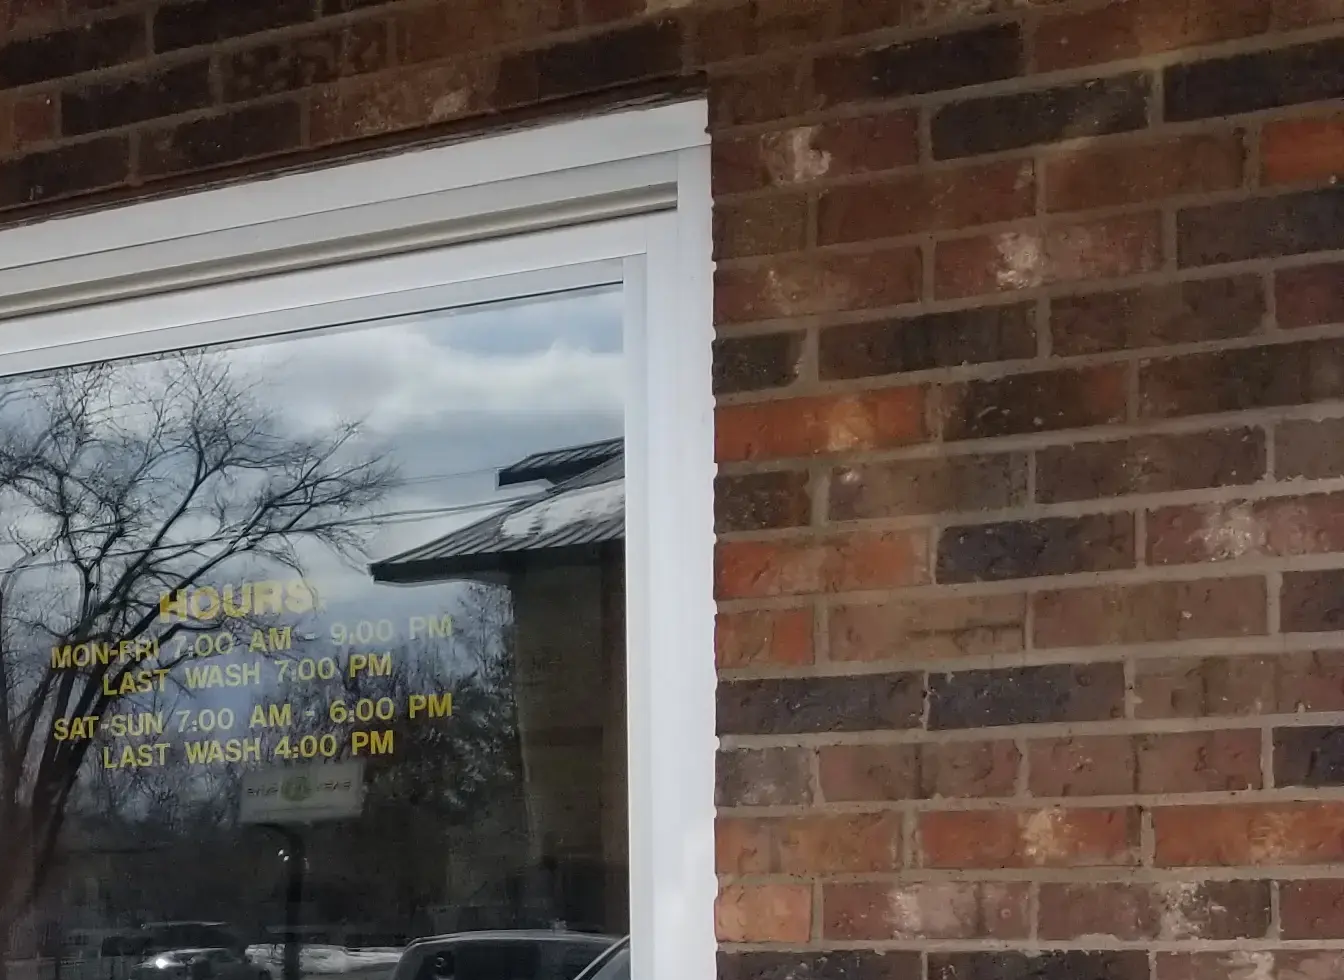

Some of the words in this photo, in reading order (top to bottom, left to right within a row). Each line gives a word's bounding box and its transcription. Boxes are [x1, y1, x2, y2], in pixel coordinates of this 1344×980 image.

[51, 639, 159, 669] MON-FRI
[173, 631, 235, 658] 7:00
[248, 626, 292, 653] AM
[330, 618, 395, 646] 9:00
[409, 614, 453, 640] PM
[103, 668, 170, 696] LAST
[184, 661, 261, 690] WASH
[274, 656, 336, 683] 7:00
[349, 651, 392, 679] PM
[53, 712, 163, 741] SAT-SUN
[175, 707, 234, 733] 7:00
[249, 704, 292, 729] AM
[329, 697, 395, 723] 6:00
[409, 692, 453, 719] PM
[103, 743, 171, 769] LAST
[184, 737, 261, 764] WASH
[274, 733, 337, 760] 4:00
[351, 729, 395, 755] PM
